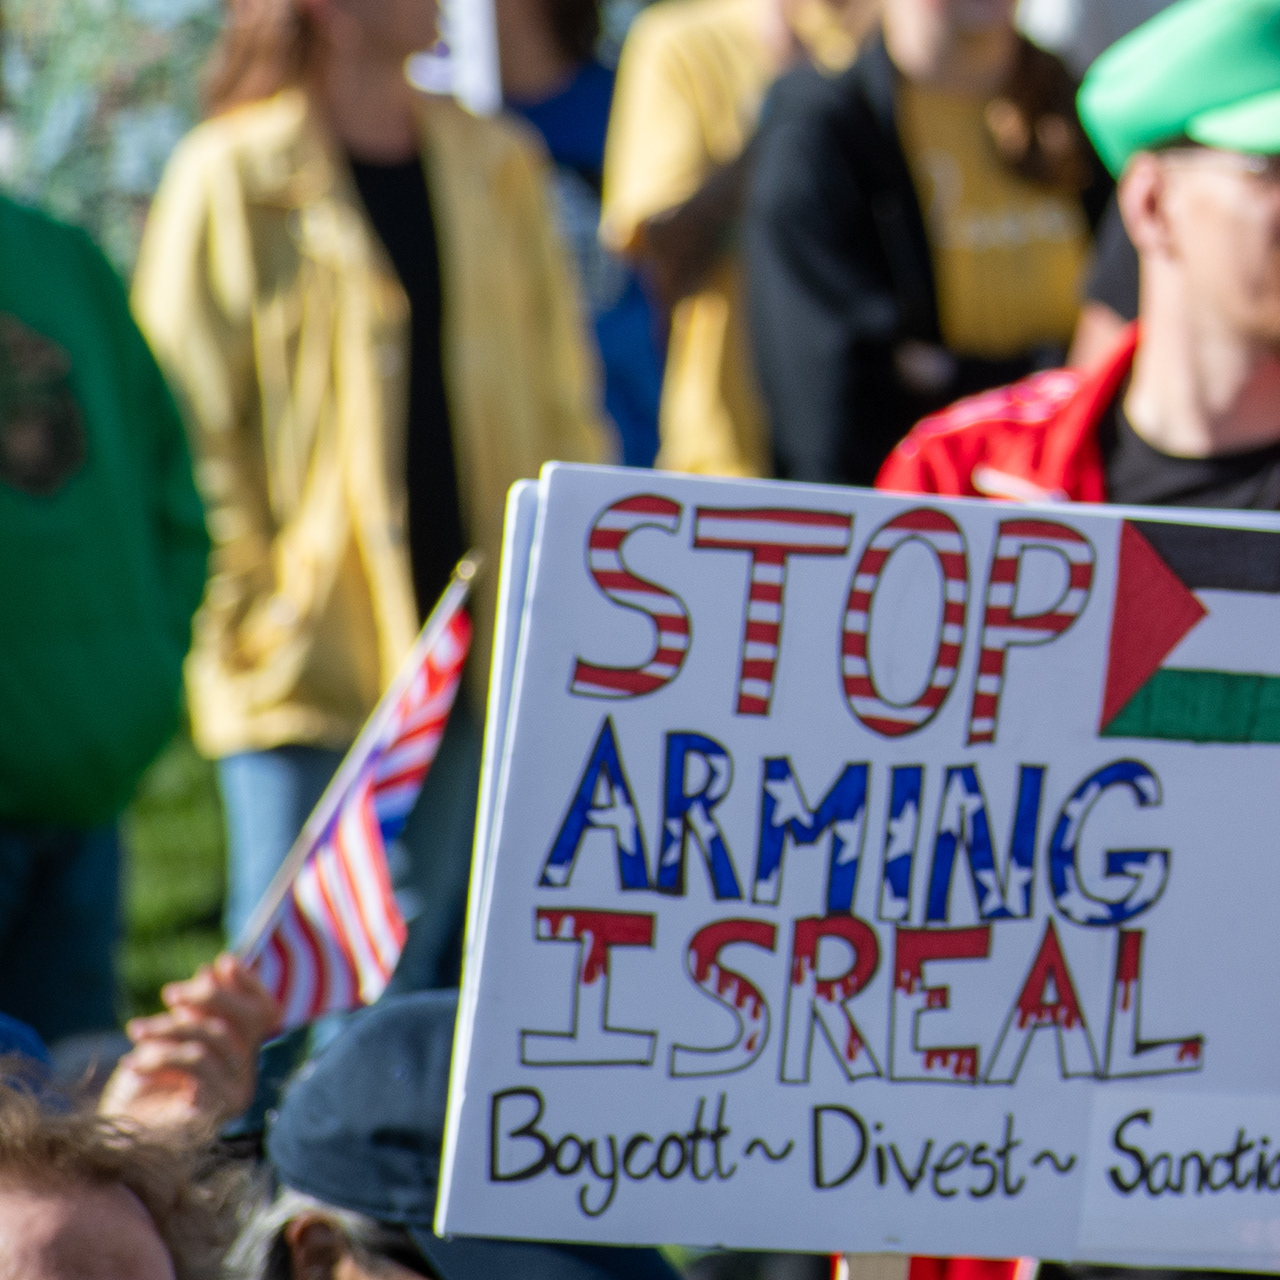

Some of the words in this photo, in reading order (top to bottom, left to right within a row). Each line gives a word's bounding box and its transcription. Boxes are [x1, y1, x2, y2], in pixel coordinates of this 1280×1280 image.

[569, 492, 1097, 746] STOP
[536, 714, 1173, 926] ARMING
[519, 906, 1206, 1086] ISREAL
